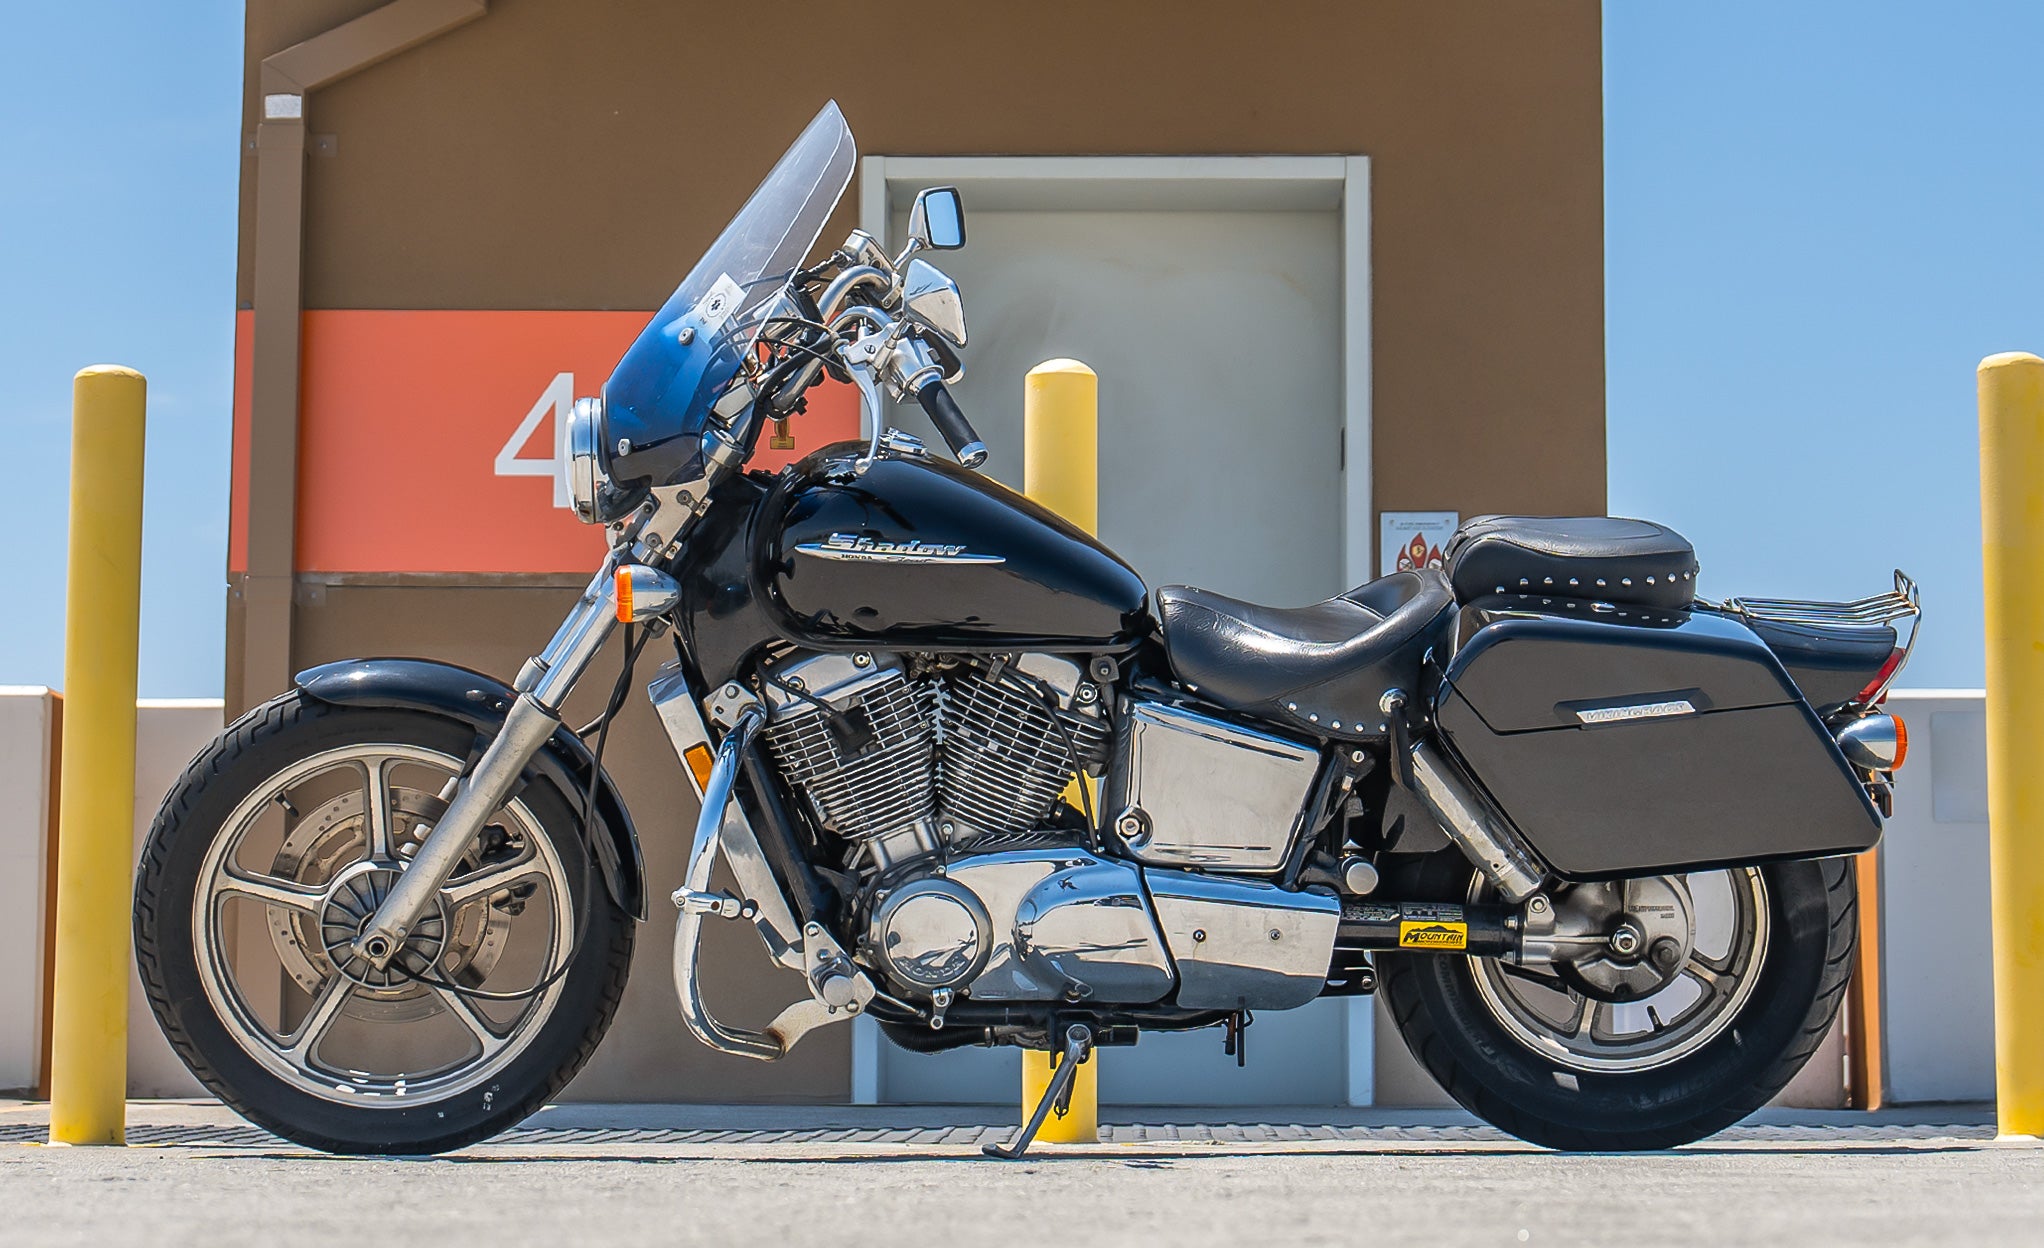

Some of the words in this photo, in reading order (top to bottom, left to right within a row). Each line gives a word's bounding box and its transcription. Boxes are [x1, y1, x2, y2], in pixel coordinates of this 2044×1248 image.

[494, 372, 574, 508] 4
[822, 532, 967, 556] Shadow
[1402, 931, 1464, 943] MOUNTAIN
[898, 956, 967, 977] HONDA
